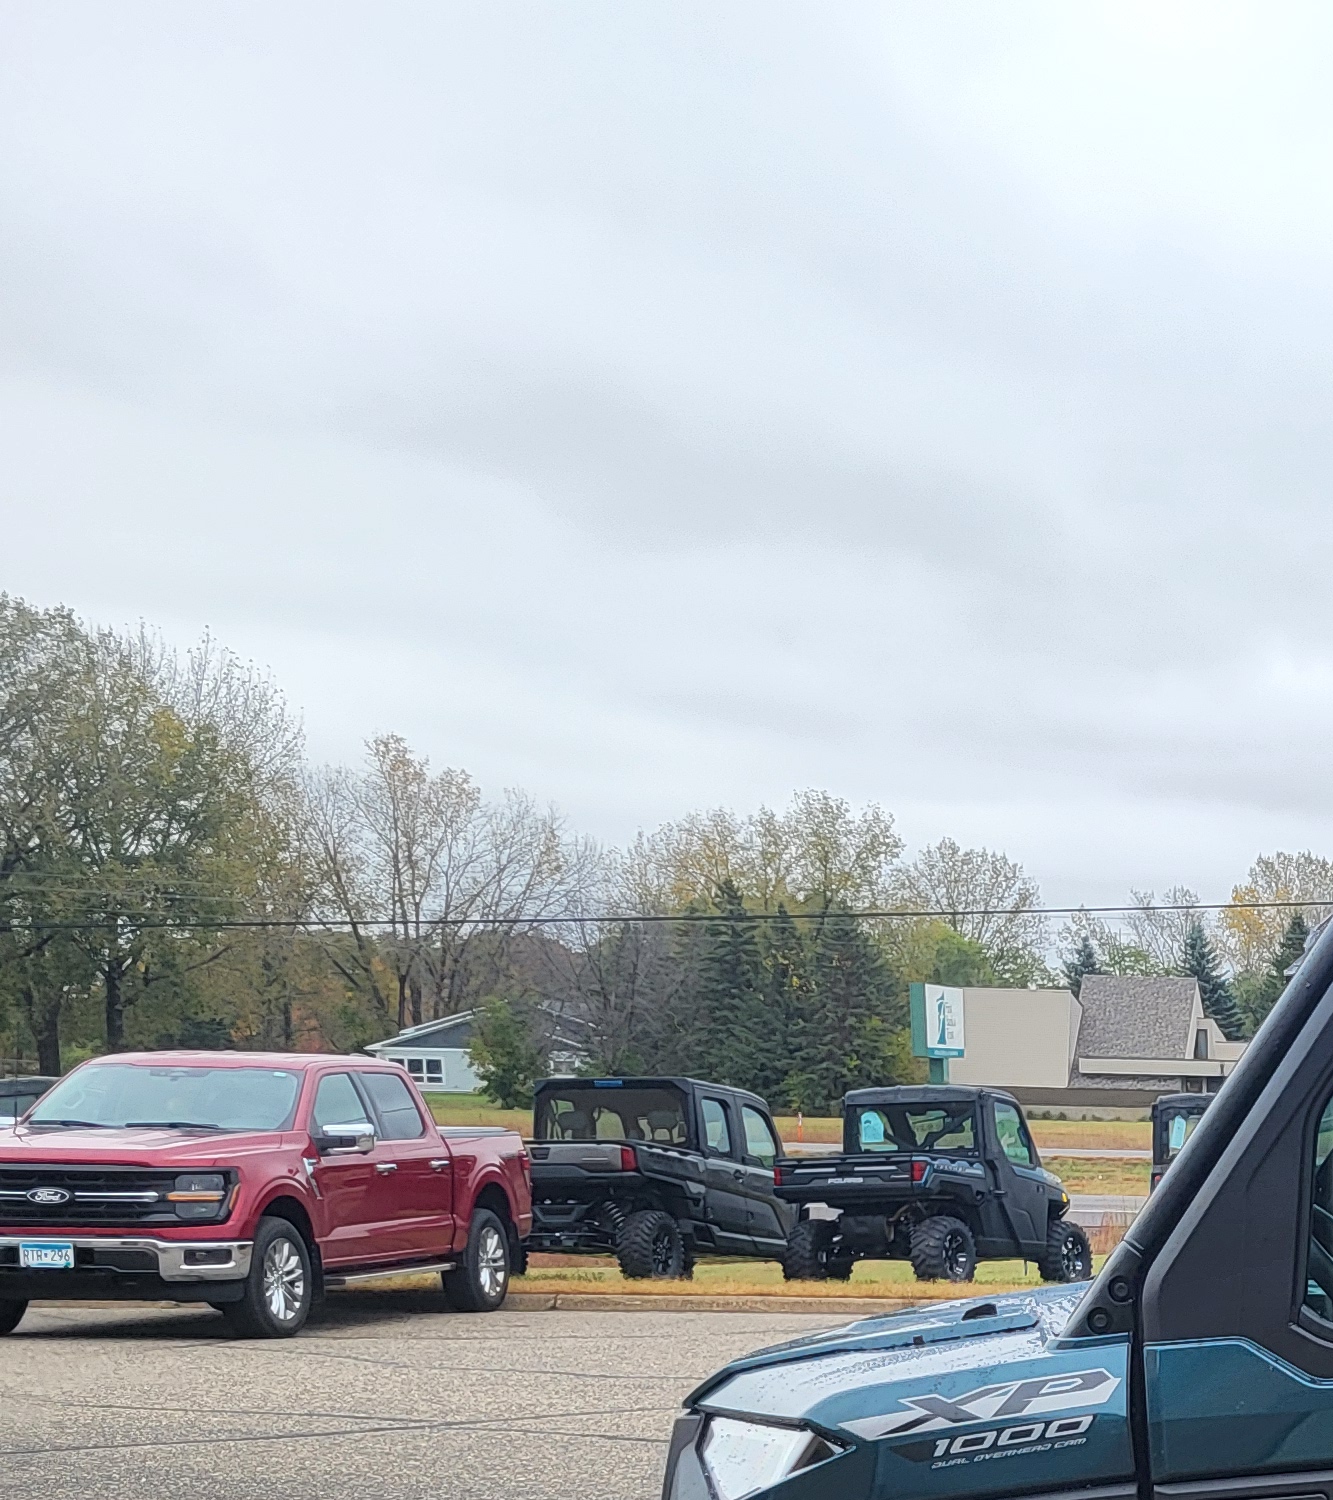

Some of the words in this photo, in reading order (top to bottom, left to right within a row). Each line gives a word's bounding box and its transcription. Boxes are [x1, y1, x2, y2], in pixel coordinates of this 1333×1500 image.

[50, 1250, 70, 1262] 296
[876, 1368, 1114, 1437] XP
[931, 1457, 970, 1469] DUAL
[973, 1443, 1052, 1462] OVERHEAD
[1053, 1437, 1087, 1450] CAM
[932, 1415, 1095, 1458] 1000
